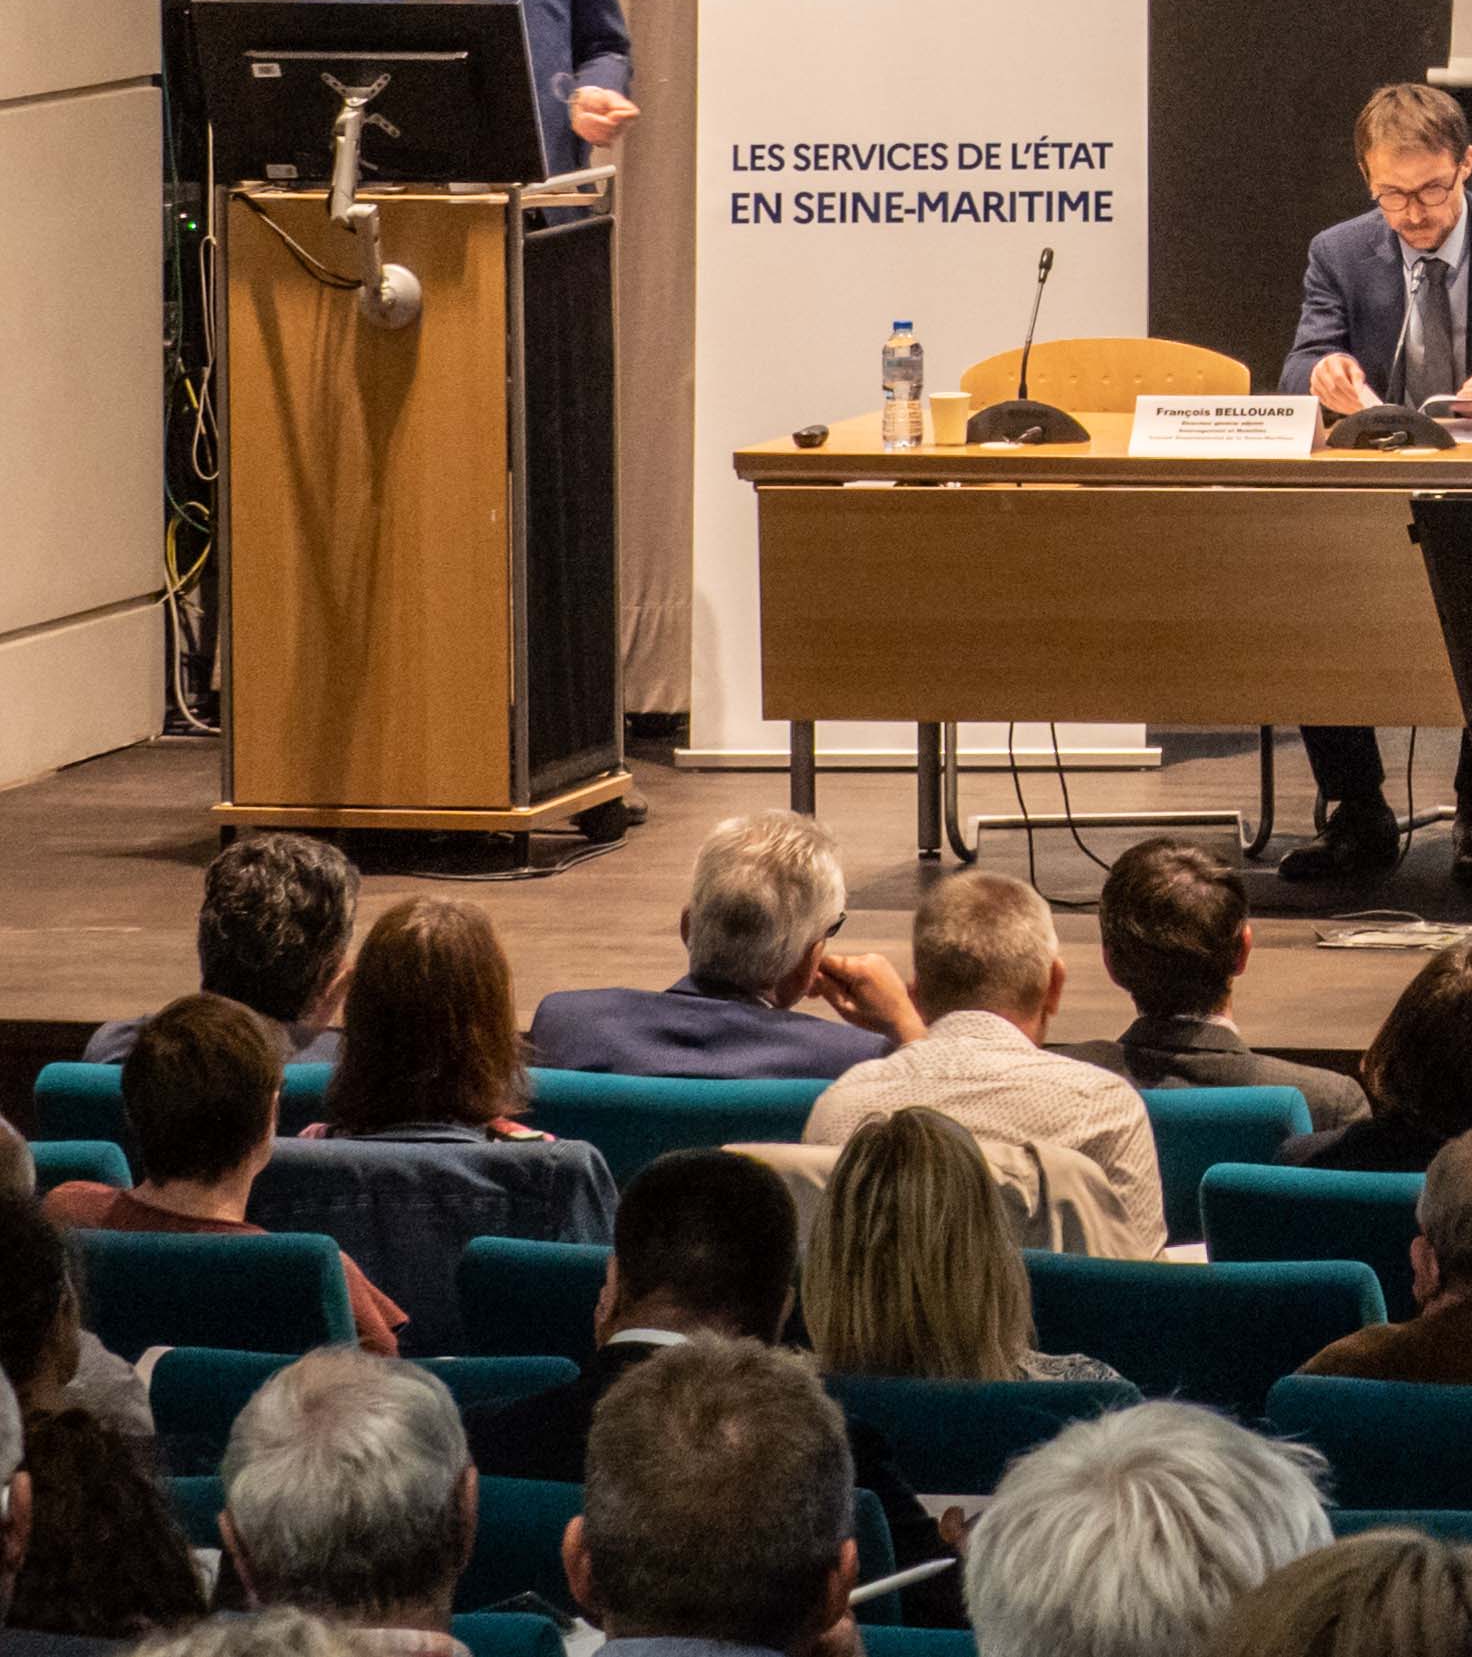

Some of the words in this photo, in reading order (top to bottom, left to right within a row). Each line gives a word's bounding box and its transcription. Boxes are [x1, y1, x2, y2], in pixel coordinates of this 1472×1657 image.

[732, 143, 785, 172] LES
[793, 142, 949, 172] SERVICES
[958, 142, 1002, 171] DE
[1011, 135, 1114, 170] L'ÉTAT
[731, 191, 783, 225] EN
[793, 190, 1114, 225] SEINE-MARITIME
[1156, 407, 1211, 418] François
[1215, 407, 1295, 417] BELLOUARD
